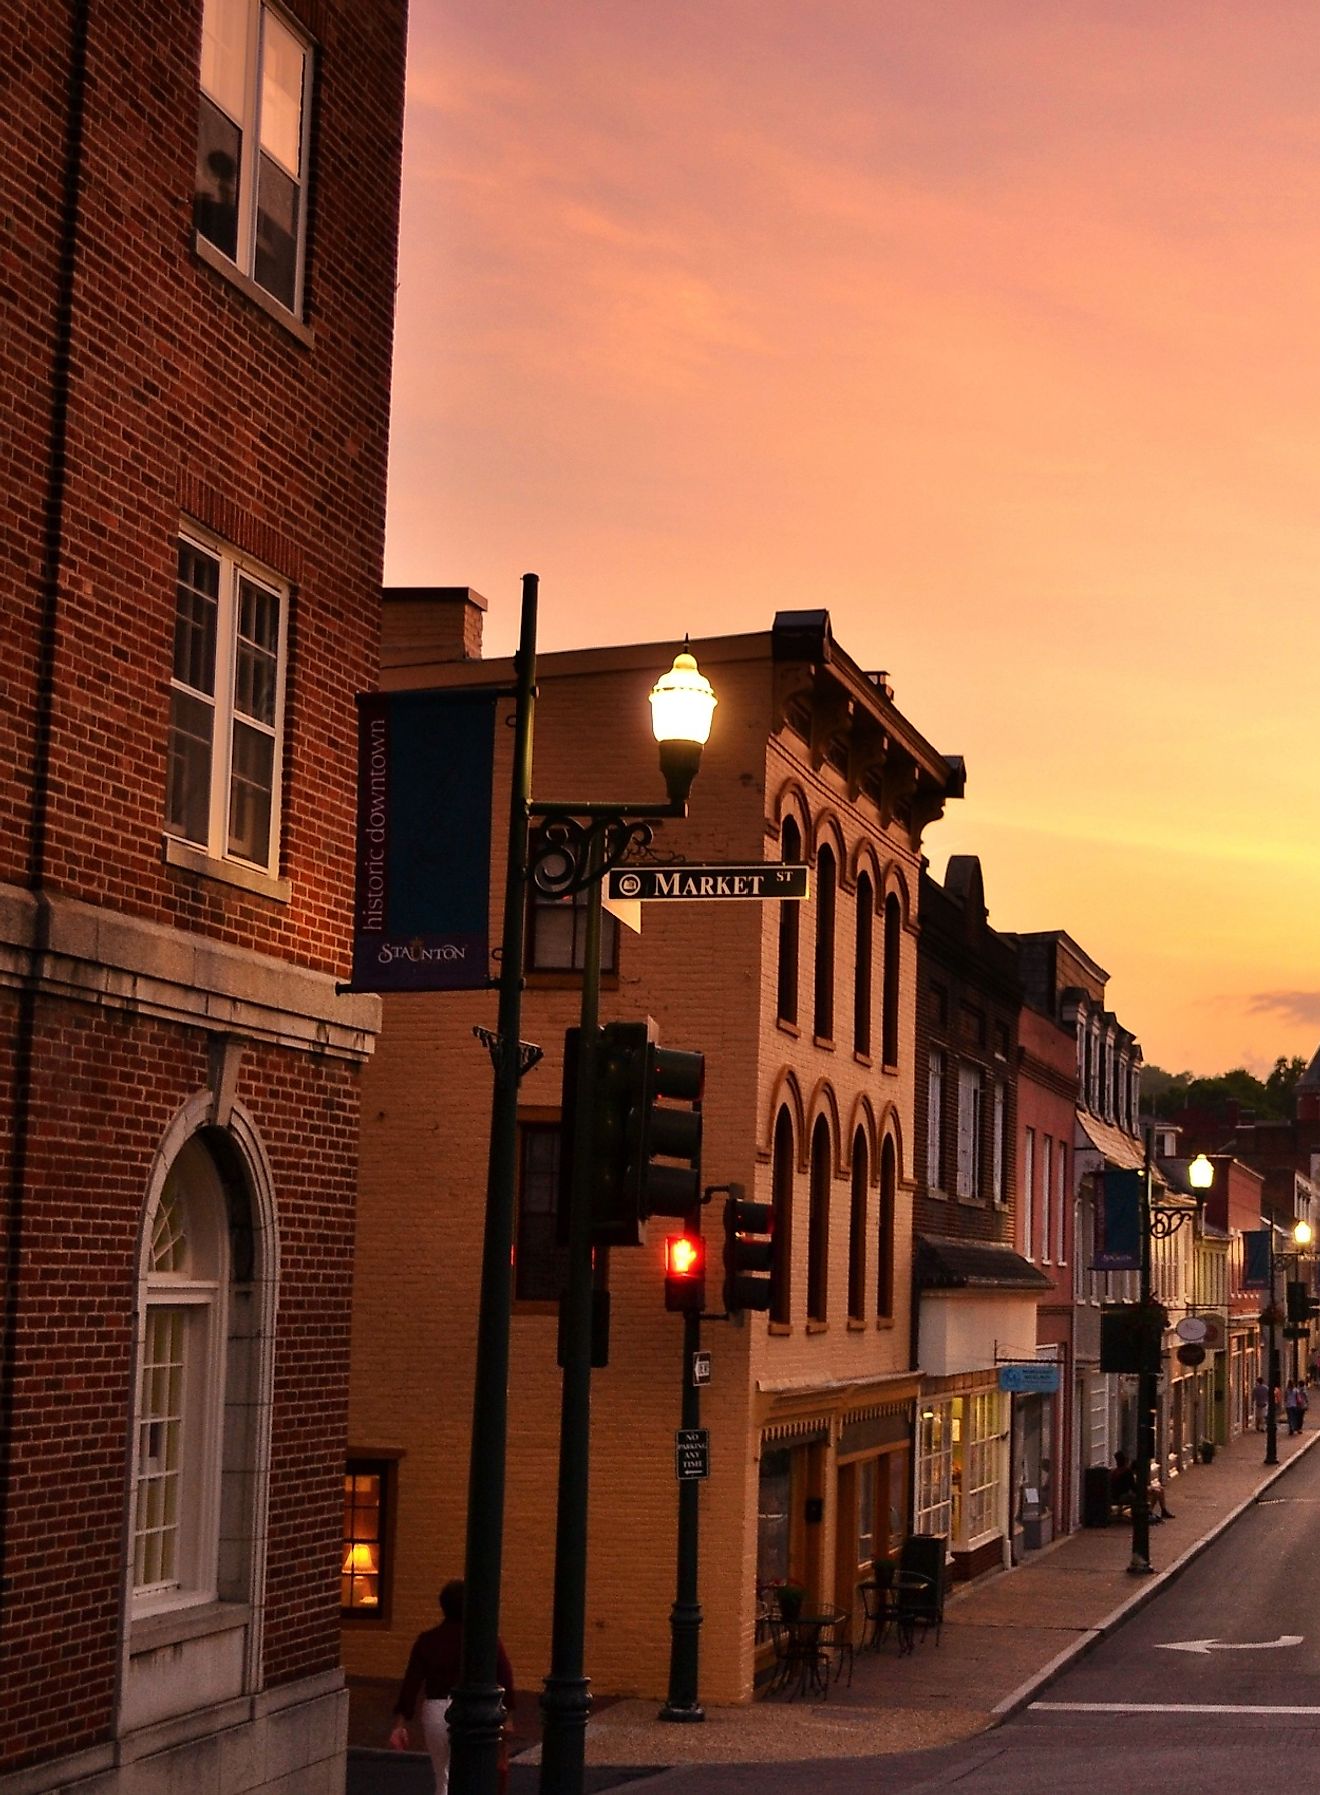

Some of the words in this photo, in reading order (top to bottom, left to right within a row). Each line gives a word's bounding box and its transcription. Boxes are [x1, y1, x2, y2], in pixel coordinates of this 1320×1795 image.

[364, 719, 387, 843] downtown
[362, 848, 385, 931] historic
[653, 872, 764, 896] MARKET
[776, 871, 794, 882] ST
[377, 942, 465, 964] STAUNTON
[686, 1434, 699, 1442] NO
[682, 1460, 703, 1468] TIME
[684, 1451, 700, 1459] ANY
